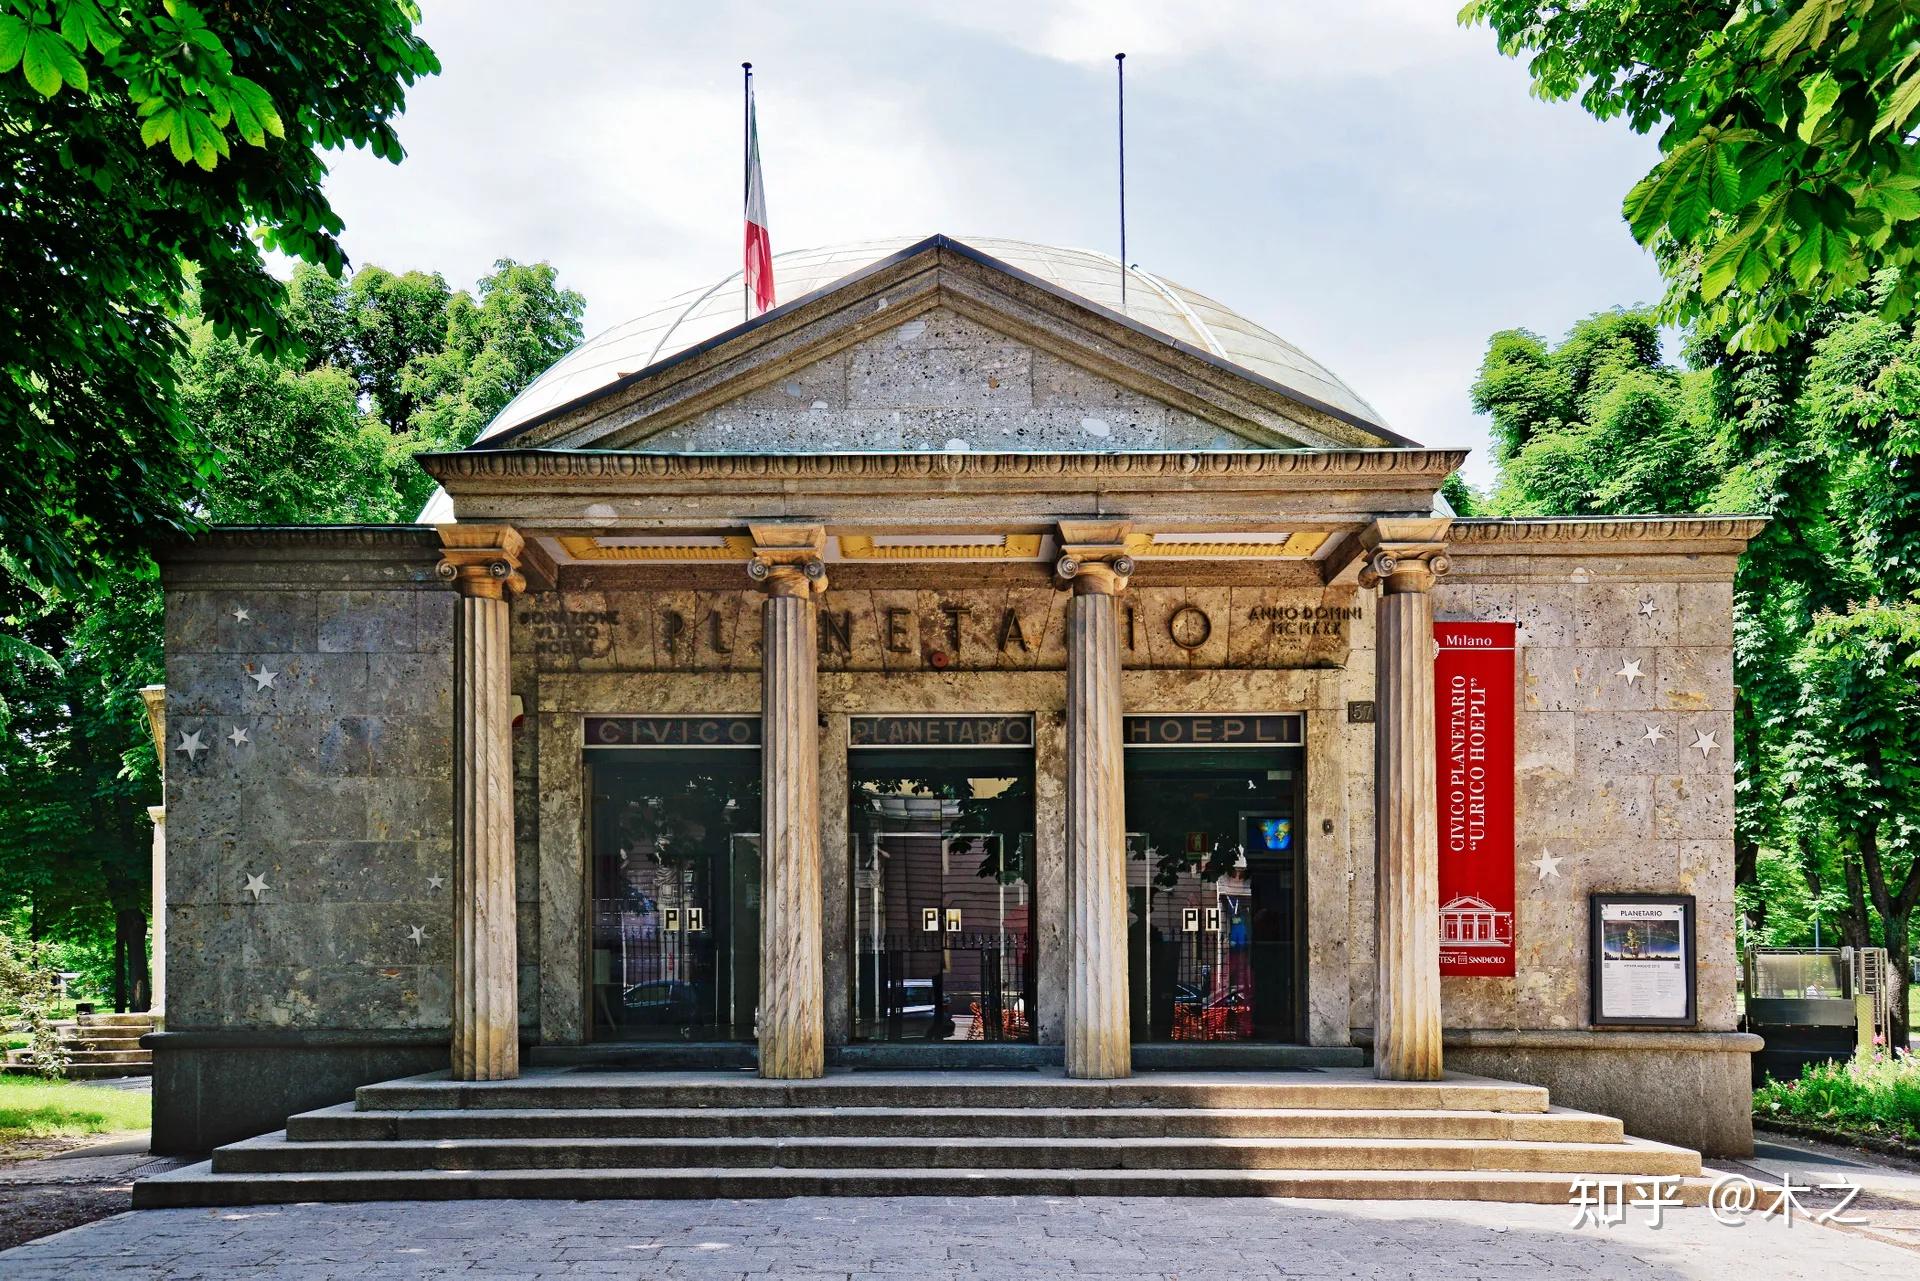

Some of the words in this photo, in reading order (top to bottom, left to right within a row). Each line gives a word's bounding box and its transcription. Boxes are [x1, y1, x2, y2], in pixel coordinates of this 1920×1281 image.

[1248, 606, 1298, 620] ANNO
[1303, 606, 1361, 620] DOMINI
[662, 606, 1212, 655] PLNETAIO
[1446, 634, 1492, 646] Milano
[1352, 703, 1373, 720] 57
[599, 720, 751, 743] CIVICO
[851, 720, 1027, 744] PLANETARIO
[1131, 719, 1288, 742] HOEPLI
[1451, 675, 1466, 786] PLANETARIO
[1451, 790, 1465, 852] CIVICO
[666, 909, 678, 930] P
[688, 909, 701, 930] H
[924, 910, 937, 930] P
[947, 911, 960, 930] H
[1184, 909, 1197, 930] P
[1207, 909, 1220, 930] H
